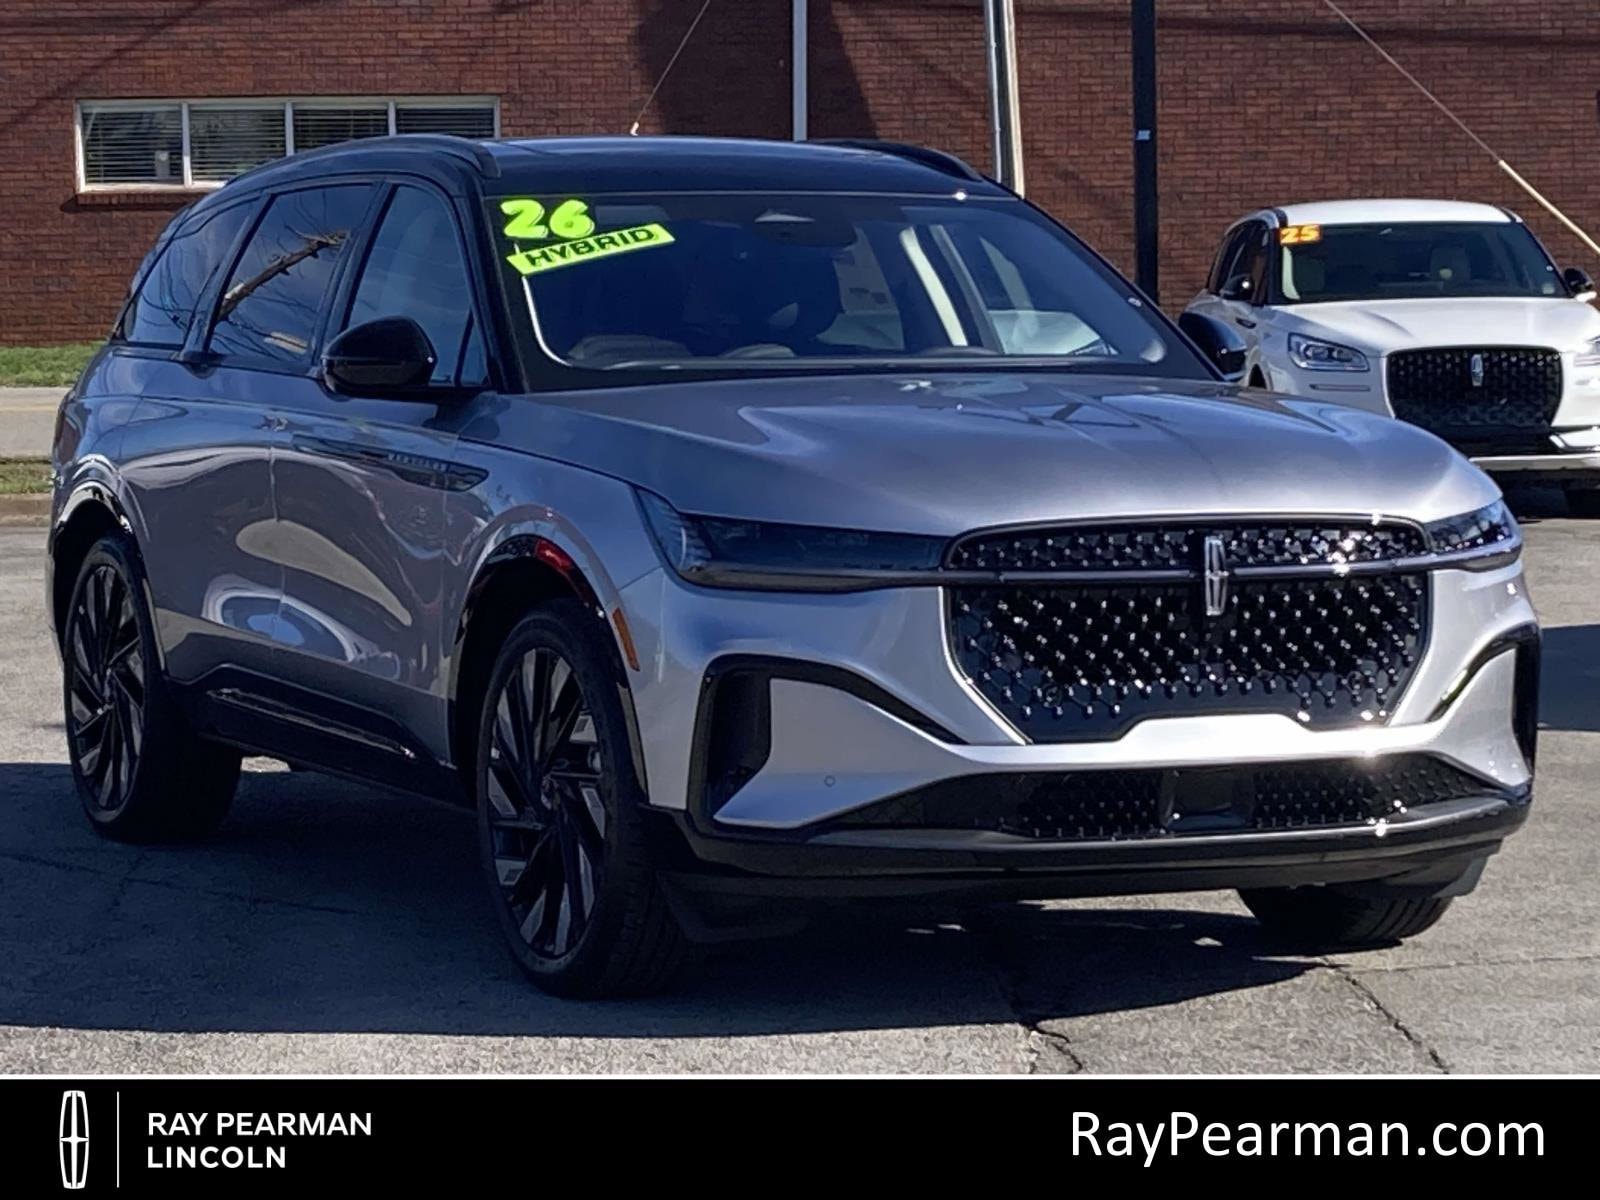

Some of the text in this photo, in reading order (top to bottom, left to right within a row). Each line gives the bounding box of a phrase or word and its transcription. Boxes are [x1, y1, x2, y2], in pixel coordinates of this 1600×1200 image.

[500, 199, 595, 239] 26
[1280, 225, 1321, 244] 25
[524, 227, 656, 267] HYBRID
